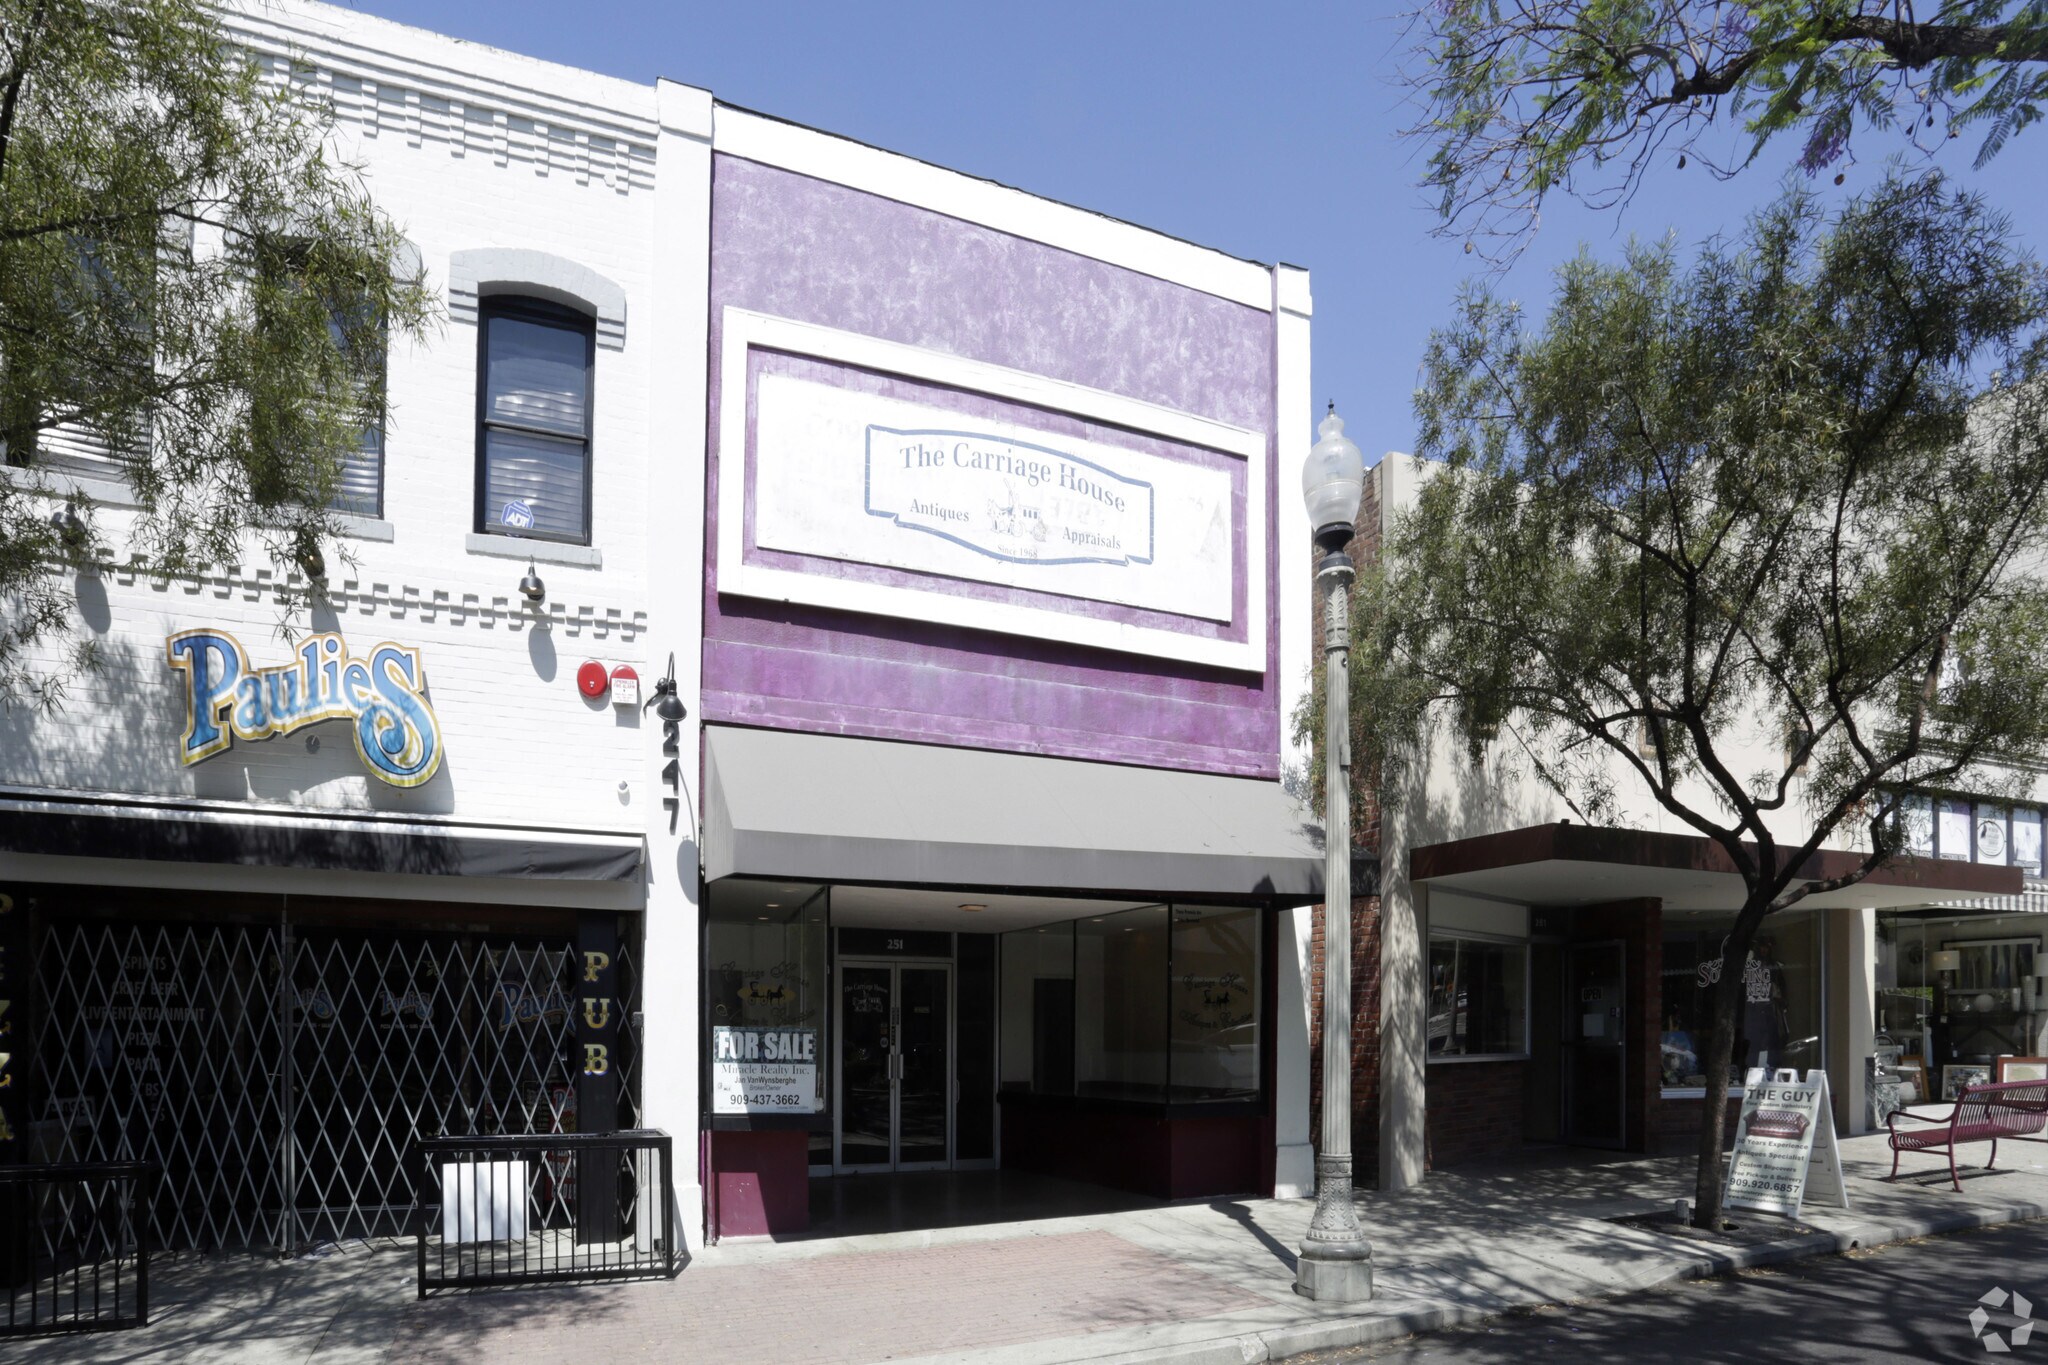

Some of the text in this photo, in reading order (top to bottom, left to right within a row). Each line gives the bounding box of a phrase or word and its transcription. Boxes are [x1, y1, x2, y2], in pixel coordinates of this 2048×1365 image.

[899, 444, 944, 469] The
[953, 441, 1051, 487] Carriage
[1058, 463, 1126, 512] House
[506, 511, 530, 528] ADT
[909, 498, 1122, 550] Antiques Appraisals
[997, 544, 1038, 559] Since 1968
[887, 939, 903, 950] 251
[1583, 988, 1602, 1000] OPEN
[1747, 983, 1771, 997] NEW
[582, 951, 611, 1076] PUB
[718, 1031, 814, 1060] FOR SALE
[721, 1064, 810, 1077] Miracle Realty Inc.
[747, 1077, 796, 1086] VanWynsberghe
[129, 1082, 160, 1096] SBS
[1748, 1089, 1816, 1103] THE GUY
[730, 1095, 800, 1105] 909-437-3662
[1768, 1141, 1809, 1150] Experience
[1736, 1149, 1805, 1161] Antiques Specialist
[1739, 1161, 1797, 1173] Custom Slipcovers
[1746, 1171, 1769, 1180] Pick-up
[1776, 1175, 1803, 1184] Delivery
[1729, 1177, 1800, 1194] 909.920.6857
